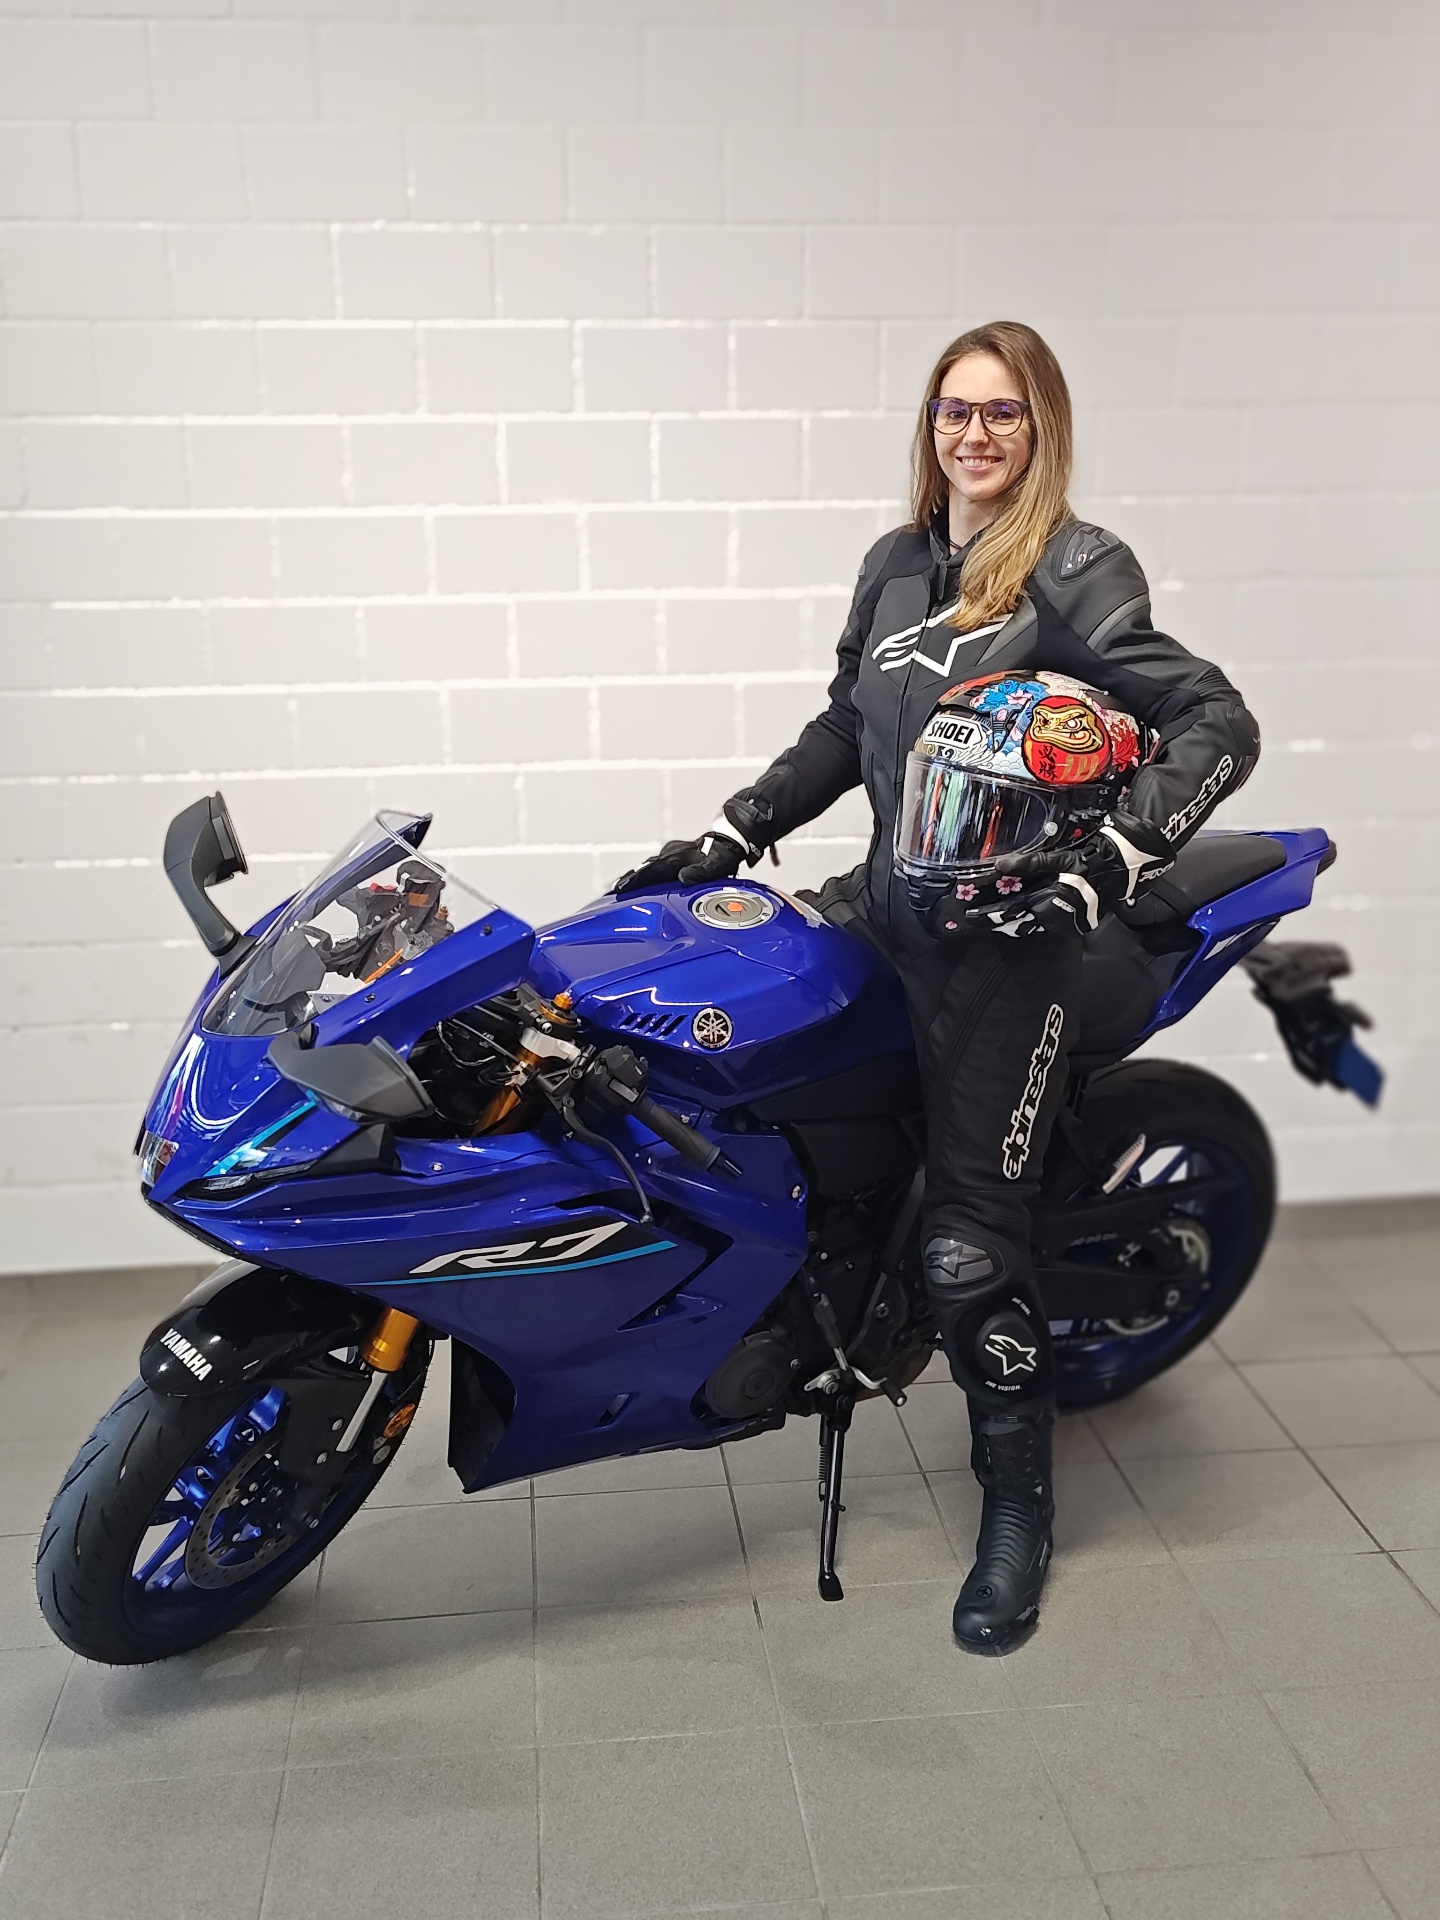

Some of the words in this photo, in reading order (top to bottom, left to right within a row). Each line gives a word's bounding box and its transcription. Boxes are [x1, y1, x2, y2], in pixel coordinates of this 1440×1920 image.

[928, 720, 974, 745] SHOEI
[1002, 1003, 1064, 1180] alpinestars
[160, 1328, 213, 1381] YAMAHA
